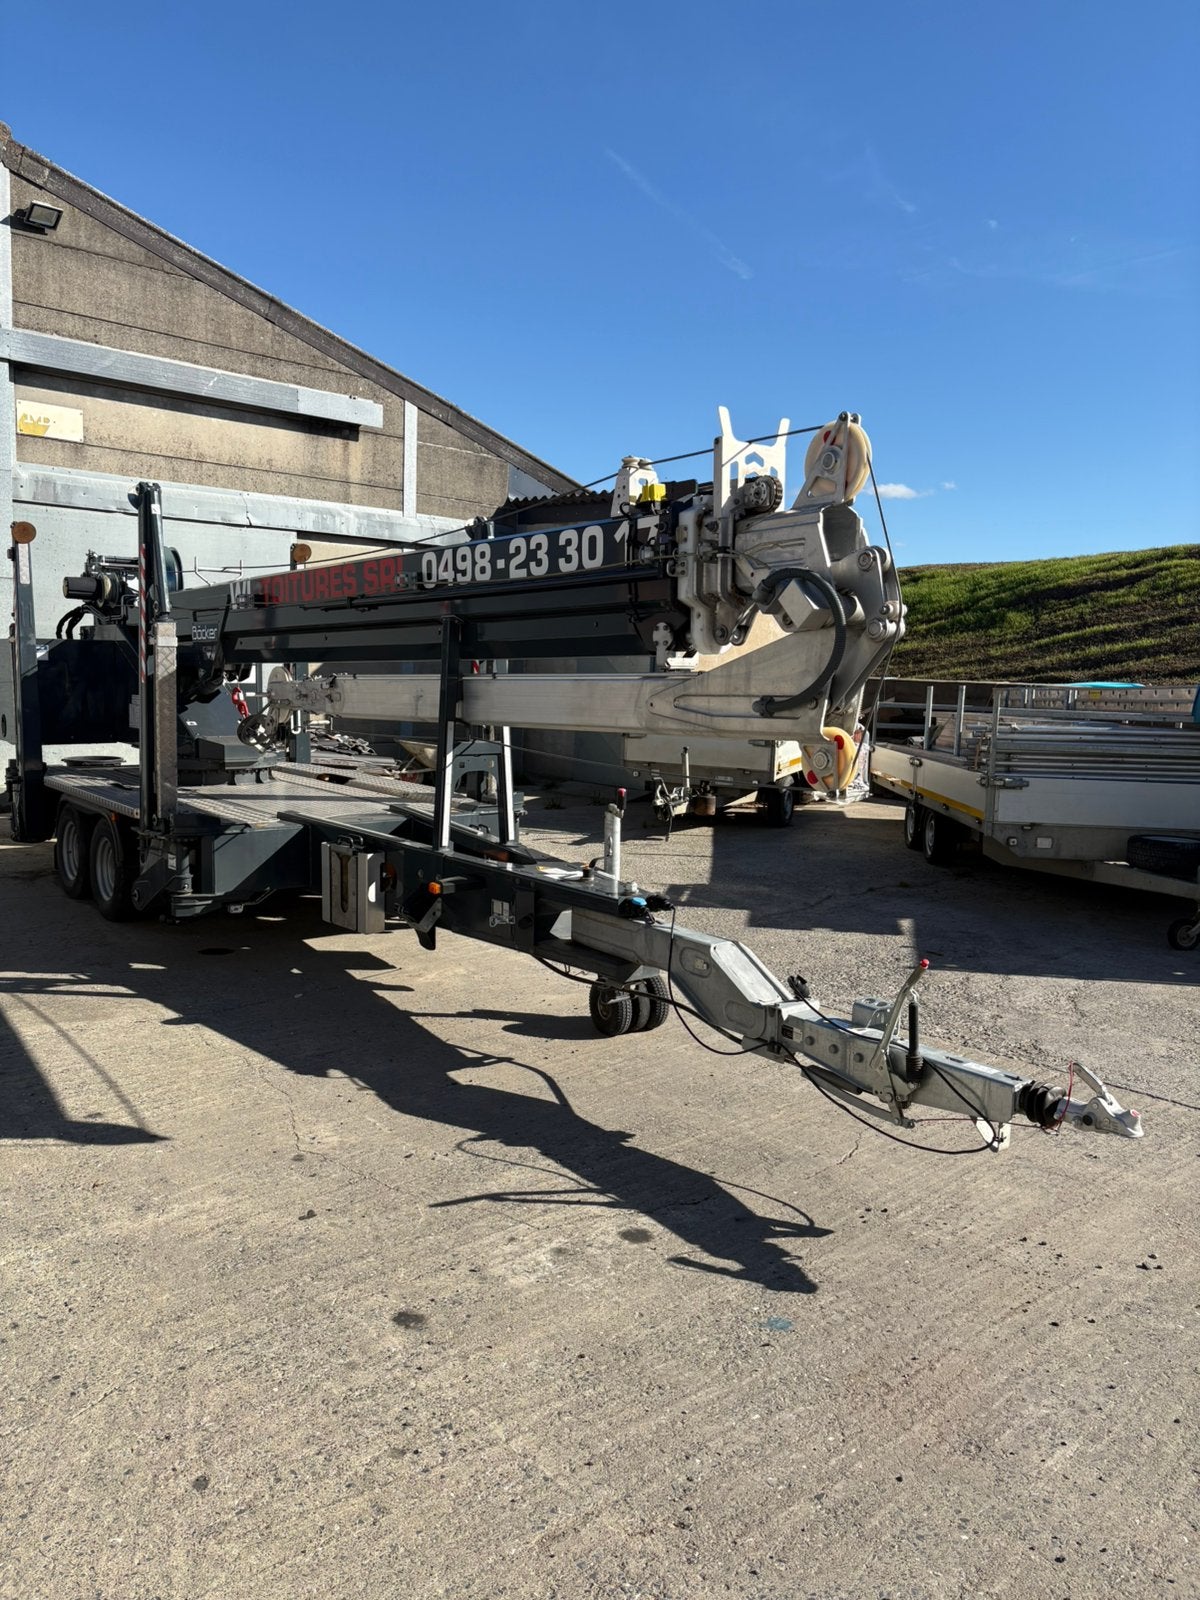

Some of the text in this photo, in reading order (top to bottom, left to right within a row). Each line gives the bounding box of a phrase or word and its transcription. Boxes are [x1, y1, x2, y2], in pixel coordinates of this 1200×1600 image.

[262, 563, 358, 607] TOITURES
[421, 534, 549, 590] 0498-23
[558, 525, 604, 573] 30
